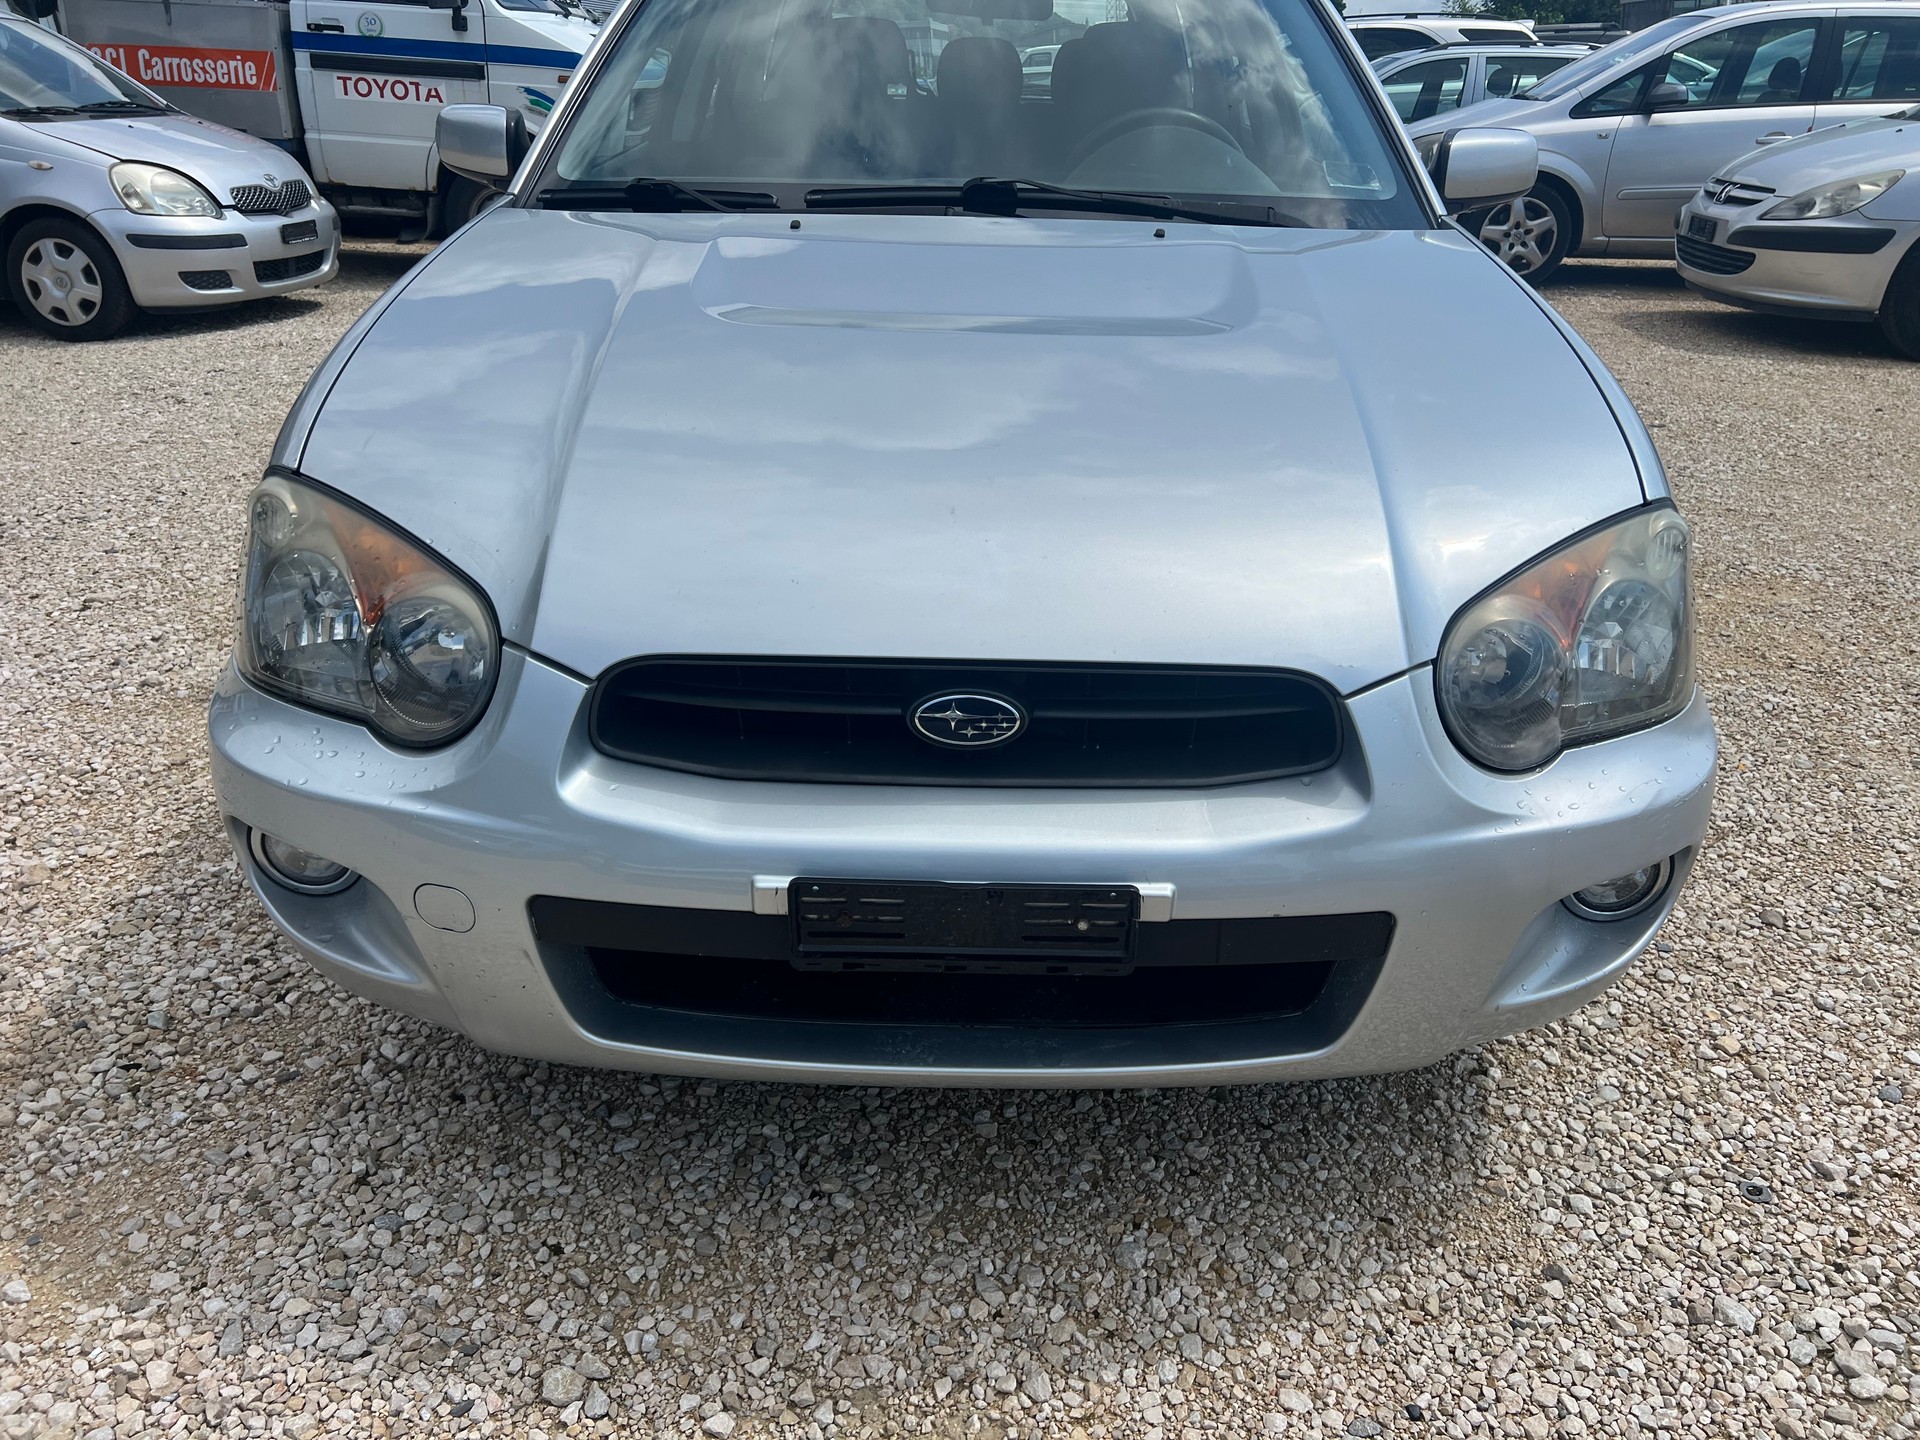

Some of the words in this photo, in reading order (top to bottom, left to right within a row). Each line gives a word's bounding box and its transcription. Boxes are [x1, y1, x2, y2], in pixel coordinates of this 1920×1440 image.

[364, 17, 377, 27] 30
[137, 48, 257, 85] Carrosserie
[336, 75, 444, 104] TOYOTA
